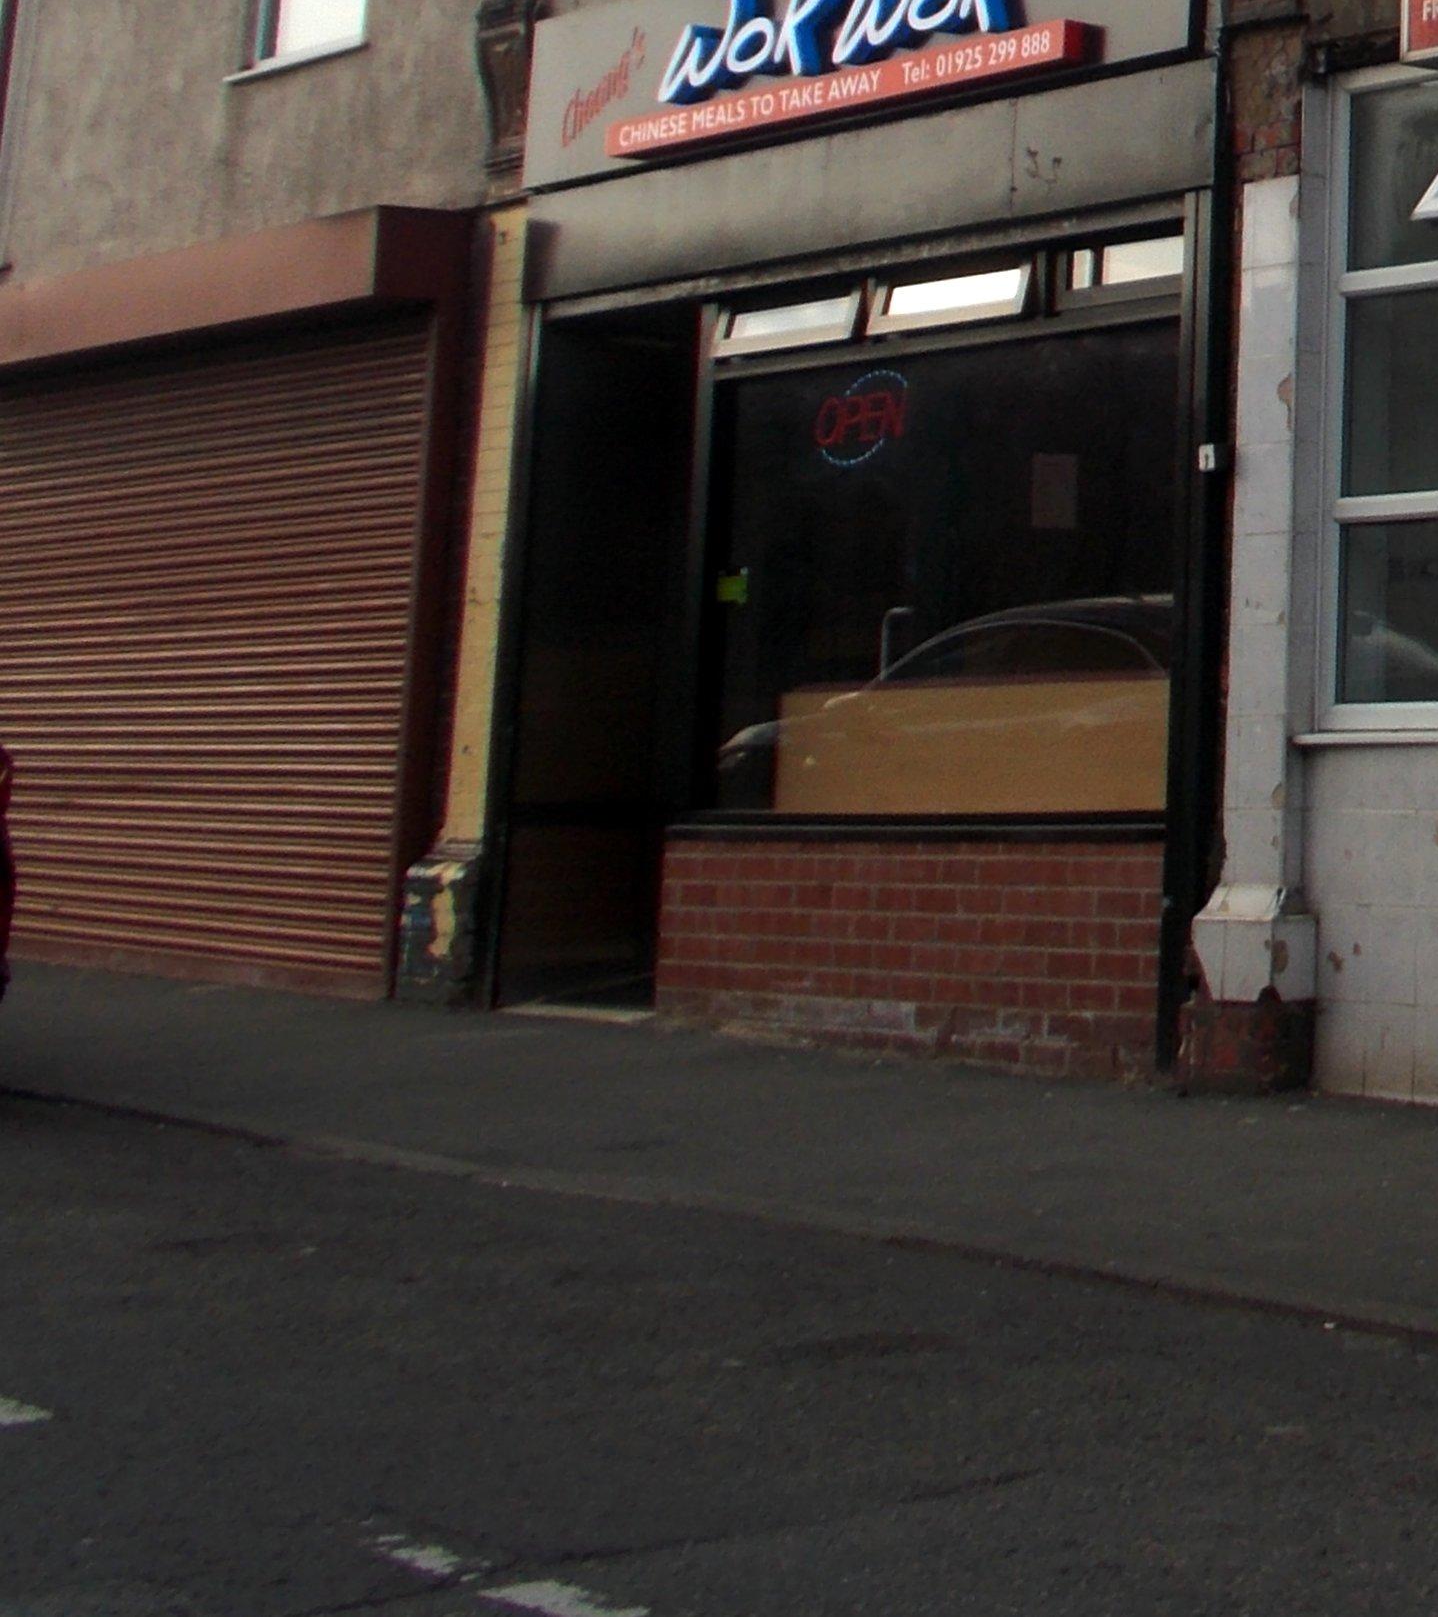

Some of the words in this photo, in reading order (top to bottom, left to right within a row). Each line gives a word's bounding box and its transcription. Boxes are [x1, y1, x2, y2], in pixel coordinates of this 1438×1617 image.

[618, 116, 688, 148] CHINESE
[691, 99, 747, 132] MEALS
[749, 93, 776, 118] TO
[780, 83, 824, 112] TAKE
[827, 68, 882, 102] AWAY
[901, 61, 931, 86] Tel:
[935, 46, 983, 76] 01925
[987, 37, 1017, 67] 299
[1020, 30, 1051, 59] 888
[816, 391, 907, 445] OPEN
